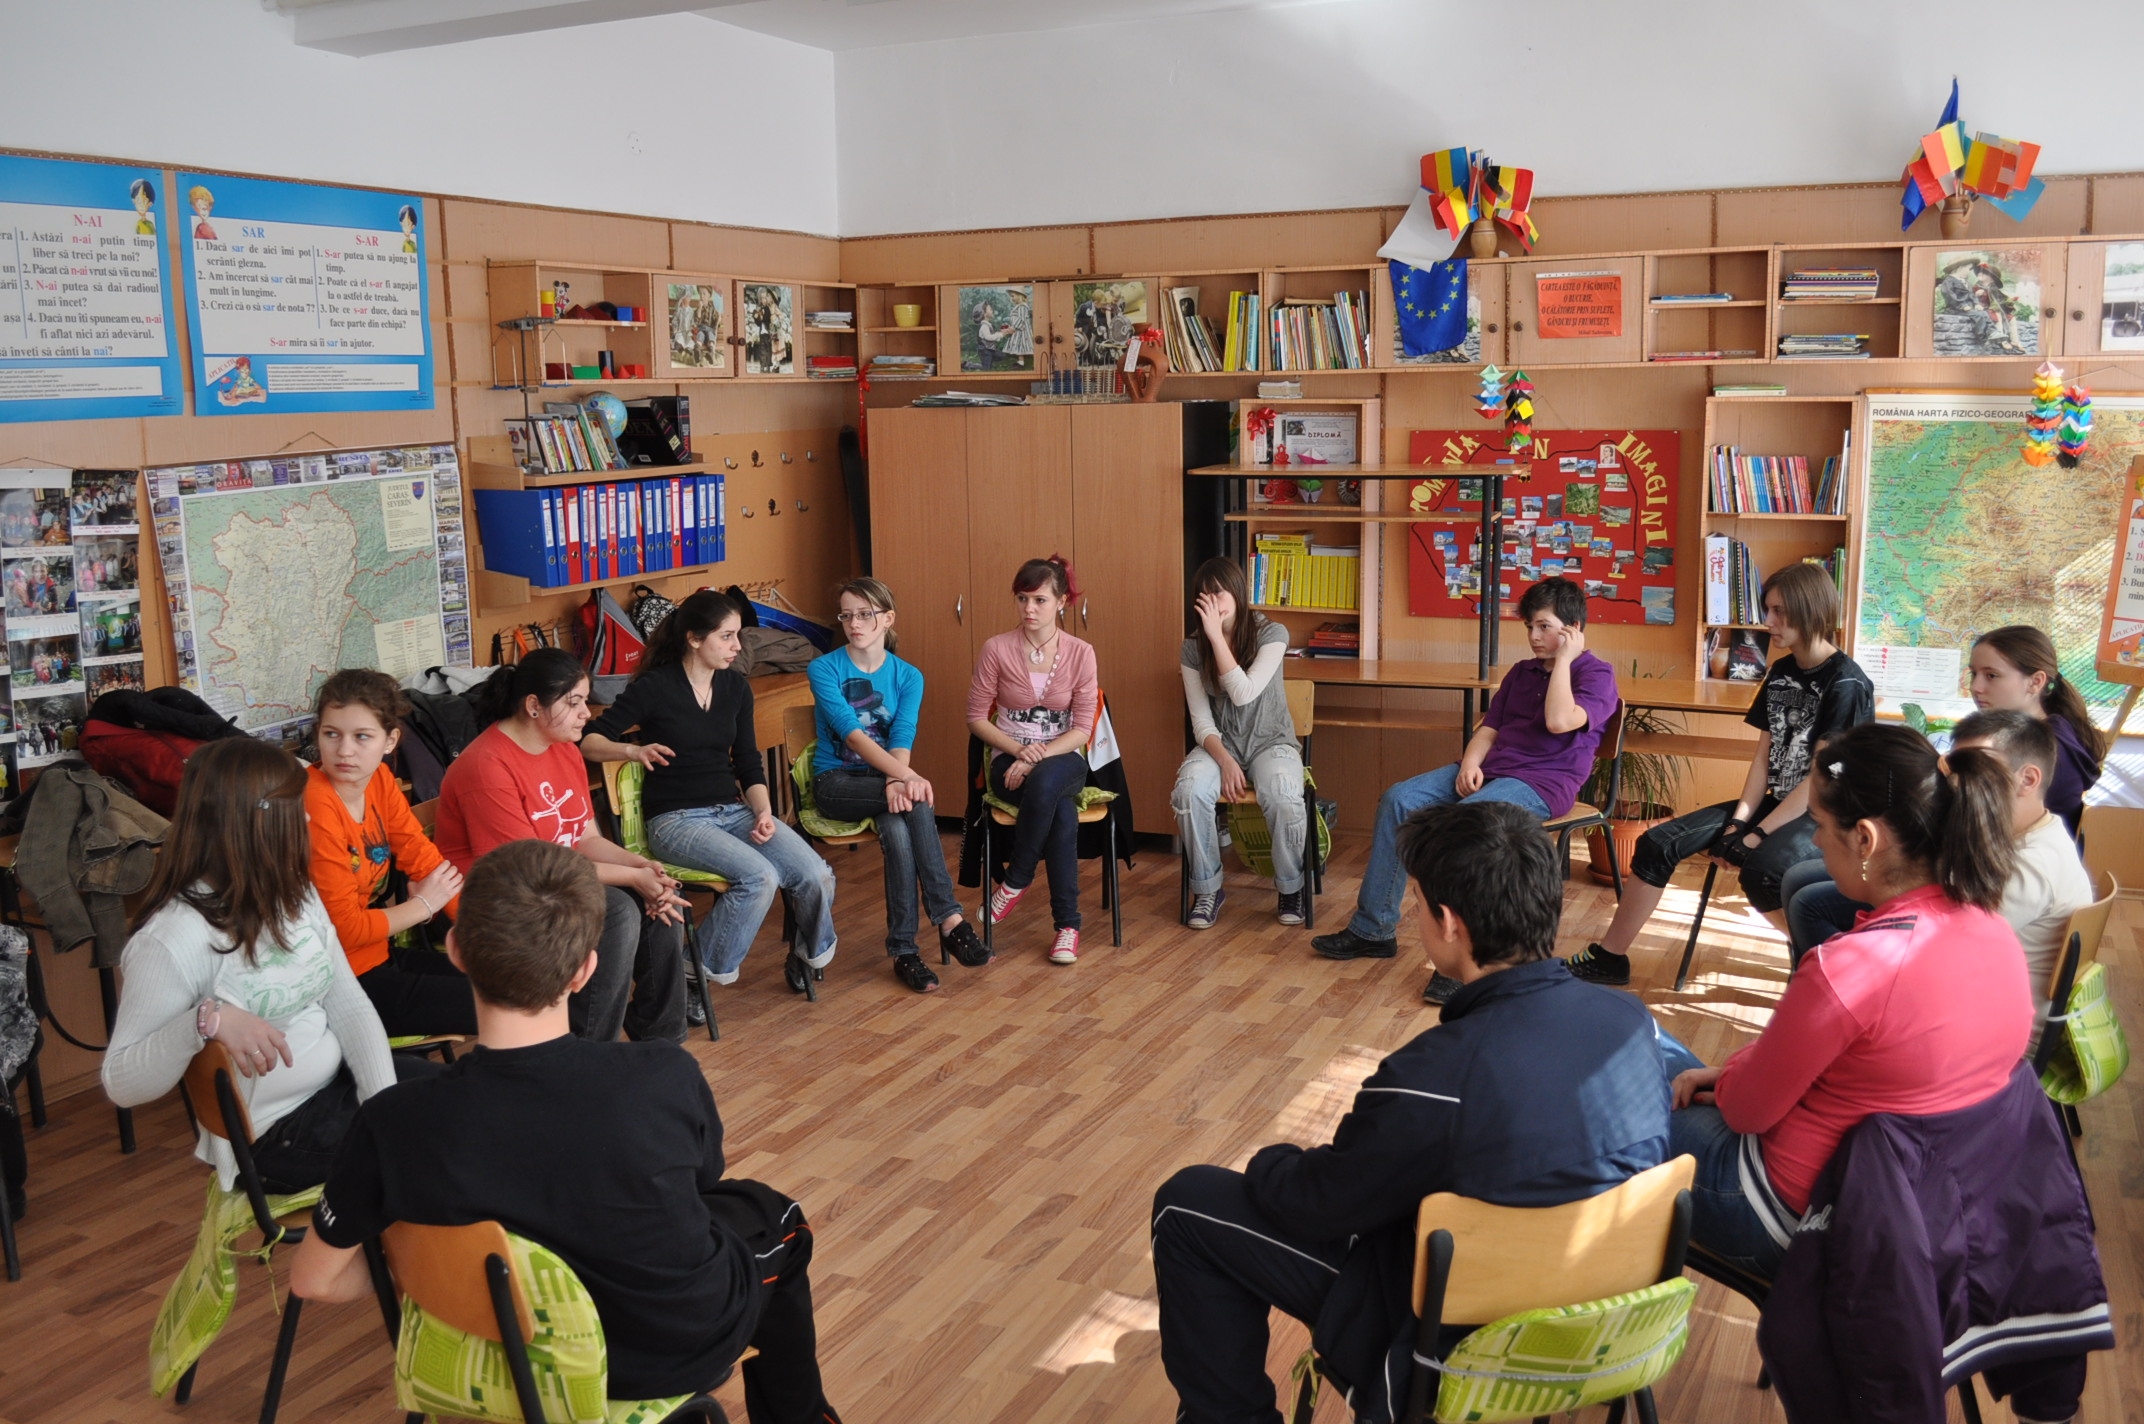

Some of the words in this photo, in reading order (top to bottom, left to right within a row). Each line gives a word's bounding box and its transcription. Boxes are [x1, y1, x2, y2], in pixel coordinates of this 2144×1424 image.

[73, 214, 103, 228] N-AI
[242, 226, 266, 238] SAR
[20, 230, 29, 241] 1.
[32, 231, 64, 243] Astăzi
[72, 234, 92, 244] n-ai
[133, 236, 156, 250] timp
[355, 235, 379, 247] S-AR
[32, 247, 56, 259] liber
[72, 250, 94, 260] treci
[96, 252, 107, 263] pe
[109, 250, 119, 262] la
[121, 251, 140, 262] noi?
[231, 244, 245, 253] sar
[249, 244, 259, 254] de
[263, 245, 277, 255] aici
[298, 248, 311, 259] pot
[324, 249, 341, 259] S-ar
[344, 252, 364, 261] putea
[377, 254, 386, 262] nu
[388, 254, 408, 265] ajung
[409, 255, 417, 264] la
[3, 265, 16, 274] un
[238, 258, 267, 269] glezna.
[325, 264, 346, 275] timp.
[32, 263, 58, 275] Păcat
[59, 265, 69, 275] că
[70, 265, 88, 276] n-ai
[89, 267, 107, 277] vrut
[130, 270, 141, 278] cu
[208, 271, 224, 281] Am
[270, 275, 284, 284] sar
[298, 275, 314, 285] mai
[326, 276, 348, 287] Poate
[360, 279, 367, 288] el
[385, 280, 391, 288] fi
[392, 281, 418, 292] angajat
[24, 279, 34, 291] 3.
[36, 279, 58, 291] N-ai
[62, 282, 89, 293] putea
[107, 281, 123, 293] dai
[126, 282, 159, 294] radioul
[209, 286, 230, 296] mult
[242, 287, 277, 299] lungime.
[37, 296, 57, 307] mai
[58, 296, 88, 307] încet?
[327, 290, 335, 300] la
[343, 291, 363, 301] astfel
[364, 292, 373, 301] de
[200, 300, 209, 310] 3.
[210, 300, 233, 311] Crezi
[245, 303, 251, 311] o
[262, 304, 275, 312] sar
[276, 303, 286, 312] de
[288, 304, 305, 313] nota
[306, 303, 315, 313] 7?
[320, 304, 328, 313] 3.
[329, 304, 339, 314] De
[27, 312, 37, 323] 4.
[65, 315, 77, 323] nu
[89, 315, 129, 326] spuneam
[131, 316, 144, 325] eu,
[145, 313, 162, 324] n-ai
[330, 318, 345, 328] face
[347, 320, 367, 330] parte
[367, 319, 380, 328] din
[40, 328, 48, 339] fi
[50, 328, 73, 339] aflat
[75, 328, 94, 339] nici
[95, 328, 110, 339] azi
[270, 337, 287, 347] S-ar
[289, 338, 308, 347] mira
[326, 339, 338, 347] sar
[349, 339, 375, 349] ajutor.
[81, 346, 91, 356] la
[93, 345, 113, 356] nai?
[1872, 407, 1915, 416] ROMÂNIA
[1917, 409, 1949, 417] HARTA
[1615, 431, 1668, 544] IMAGINI
